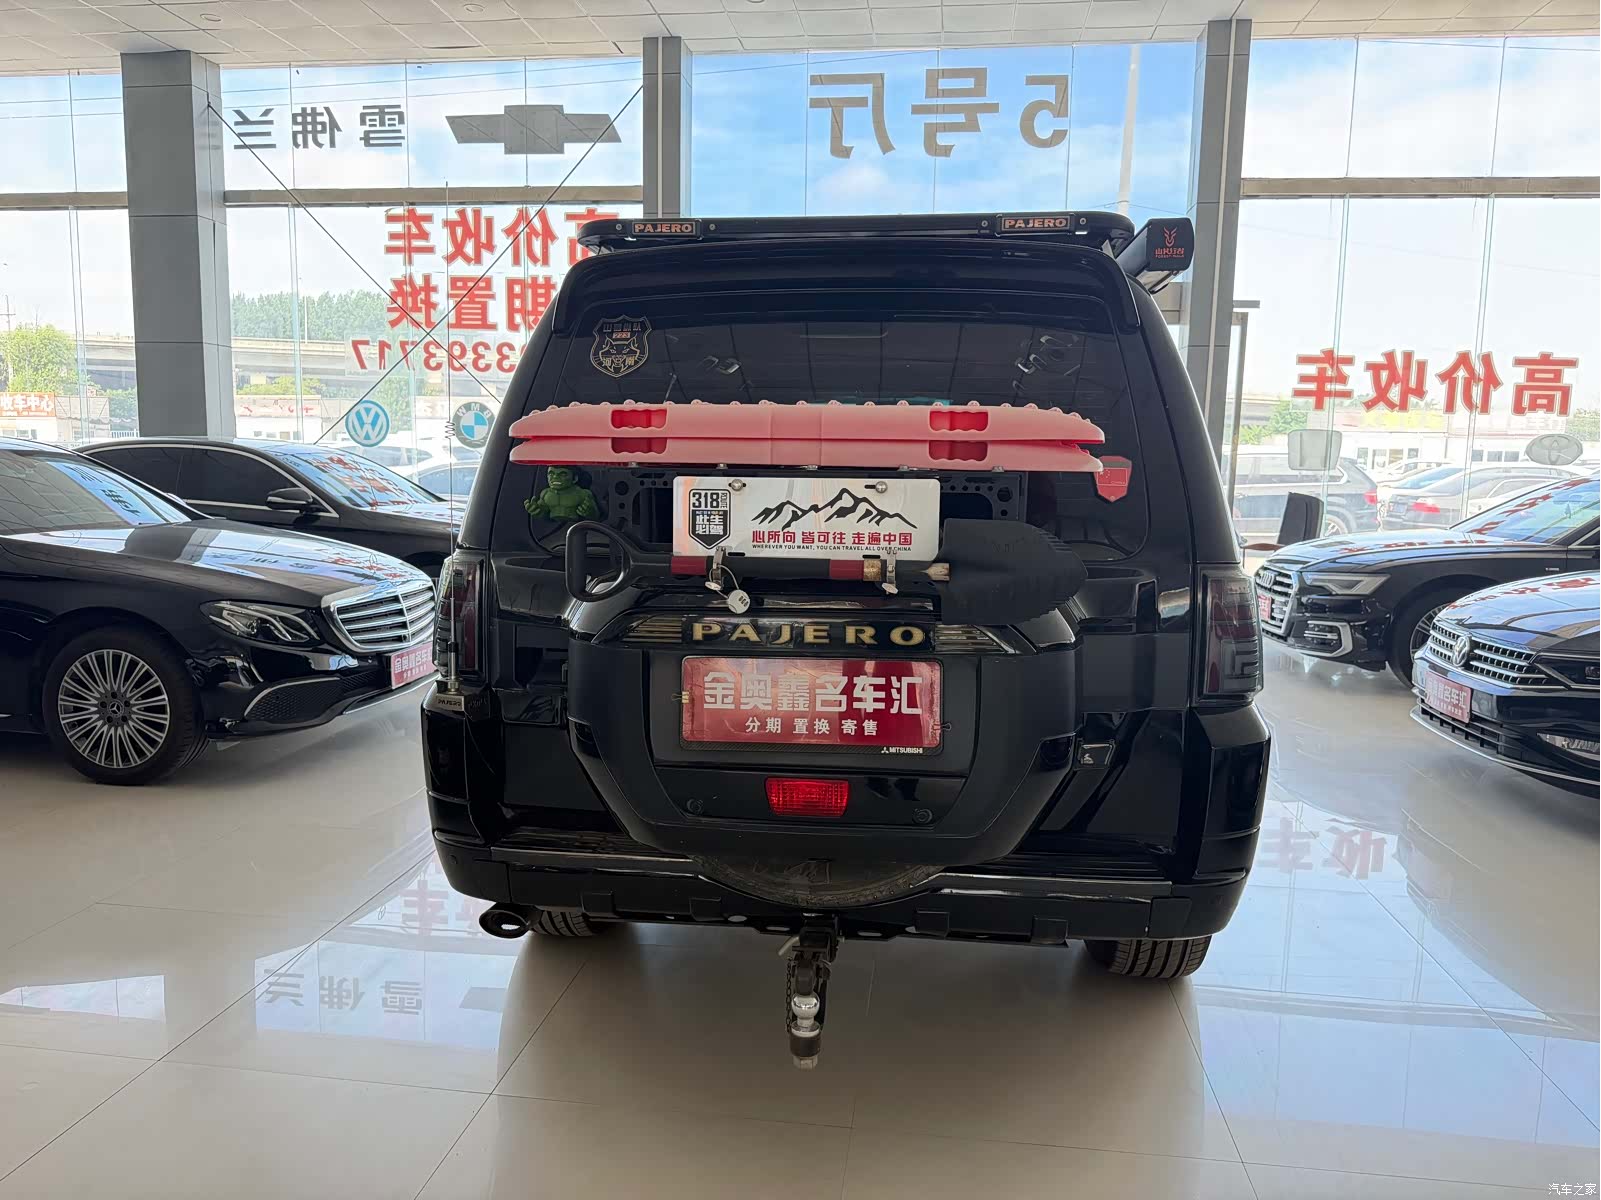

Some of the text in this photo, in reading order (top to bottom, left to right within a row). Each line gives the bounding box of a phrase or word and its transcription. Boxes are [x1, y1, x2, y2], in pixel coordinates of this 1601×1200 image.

[634, 223, 693, 234] PAJERO
[1003, 217, 1067, 230] PAJERO
[692, 492, 720, 508] 318
[752, 530, 912, 546] 心所向 皆可往 走遍中国
[692, 622, 926, 646] PAJERO
[703, 671, 924, 715] 金奥鑫名车汇
[744, 717, 879, 736] 分期 置换 寄售
[889, 746, 923, 754] MITSUBISHI
